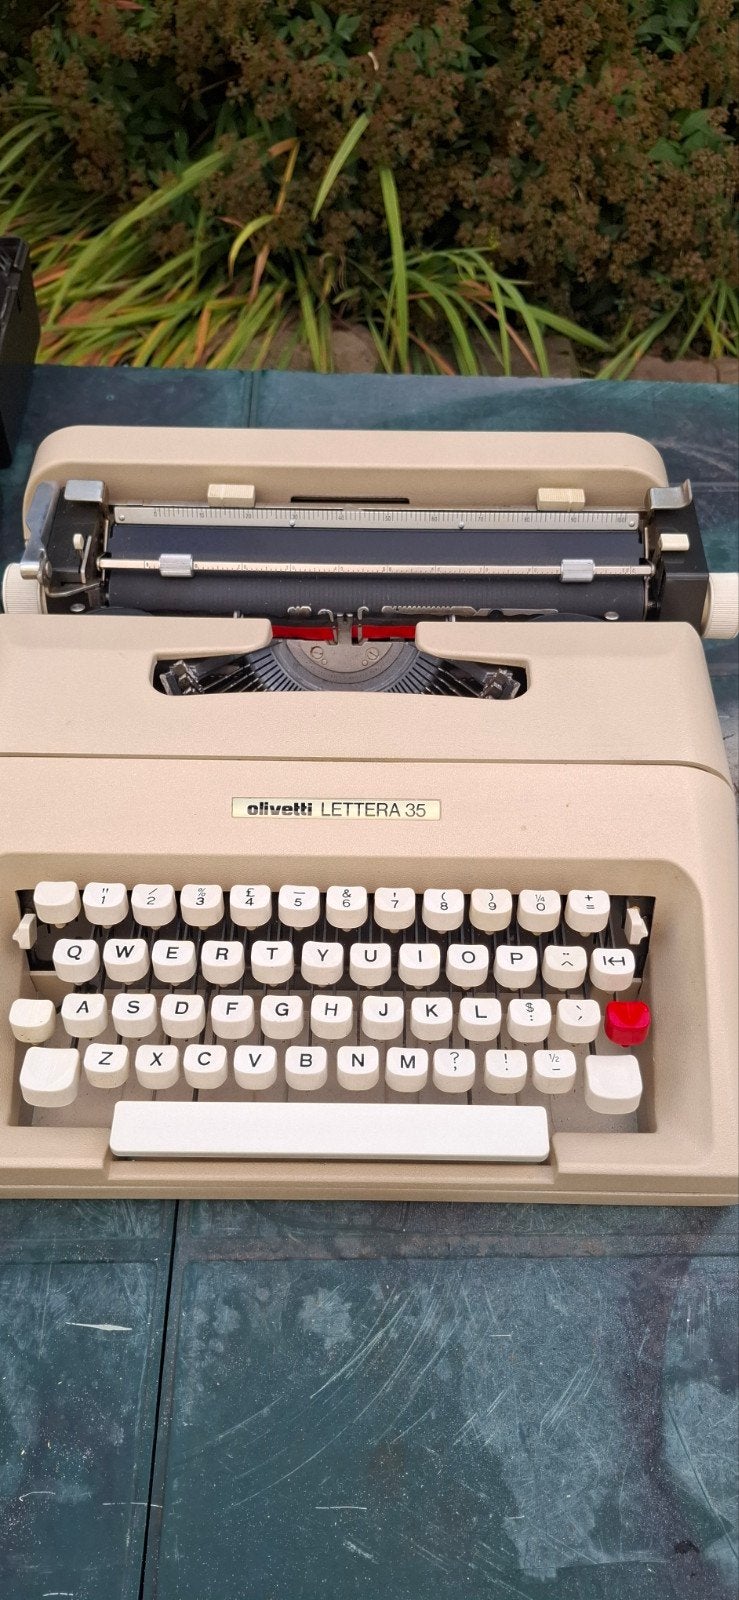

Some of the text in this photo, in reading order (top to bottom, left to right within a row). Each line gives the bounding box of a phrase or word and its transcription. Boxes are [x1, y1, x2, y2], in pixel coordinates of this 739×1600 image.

[247, 801, 426, 817] olivetti LETTERA 35
[198, 888, 206, 896] %
[245, 887, 254, 897] £
[342, 888, 352, 898] &
[441, 892, 447, 902] (
[489, 892, 495, 902] )
[585, 893, 593, 901] +
[102, 896, 106, 905] 1
[147, 897, 156, 906] 2
[196, 897, 205, 906] 3
[245, 897, 254, 907] 4
[294, 898, 302, 907] 5
[343, 899, 351, 908] 6
[391, 900, 399, 909] 7
[440, 902, 448, 911] 8
[488, 902, 496, 911] 9
[67, 945, 82, 960] Q
[115, 945, 135, 959] W
[166, 947, 179, 959] E
[216, 948, 228, 961] R
[267, 948, 278, 960] T
[317, 948, 329, 961] Y
[365, 950, 377, 963] U
[418, 950, 422, 963] I
[462, 951, 475, 964] O
[510, 953, 523, 965] P
[76, 1001, 89, 1014] A
[126, 1001, 140, 1014] S
[175, 1001, 189, 1015] D
[226, 1002, 238, 1016] F
[275, 1003, 289, 1017] G
[325, 1003, 338, 1017] H
[379, 1003, 388, 1017] J
[426, 1004, 439, 1018] K
[475, 1005, 488, 1018] L
[525, 1002, 534, 1013] $
[98, 1052, 113, 1066] Z
[150, 1052, 163, 1067] X
[198, 1052, 211, 1066] C
[249, 1054, 262, 1067] V
[300, 1054, 312, 1068] B
[352, 1054, 364, 1068] N
[401, 1055, 415, 1069] M
[449, 1051, 459, 1064] ?
